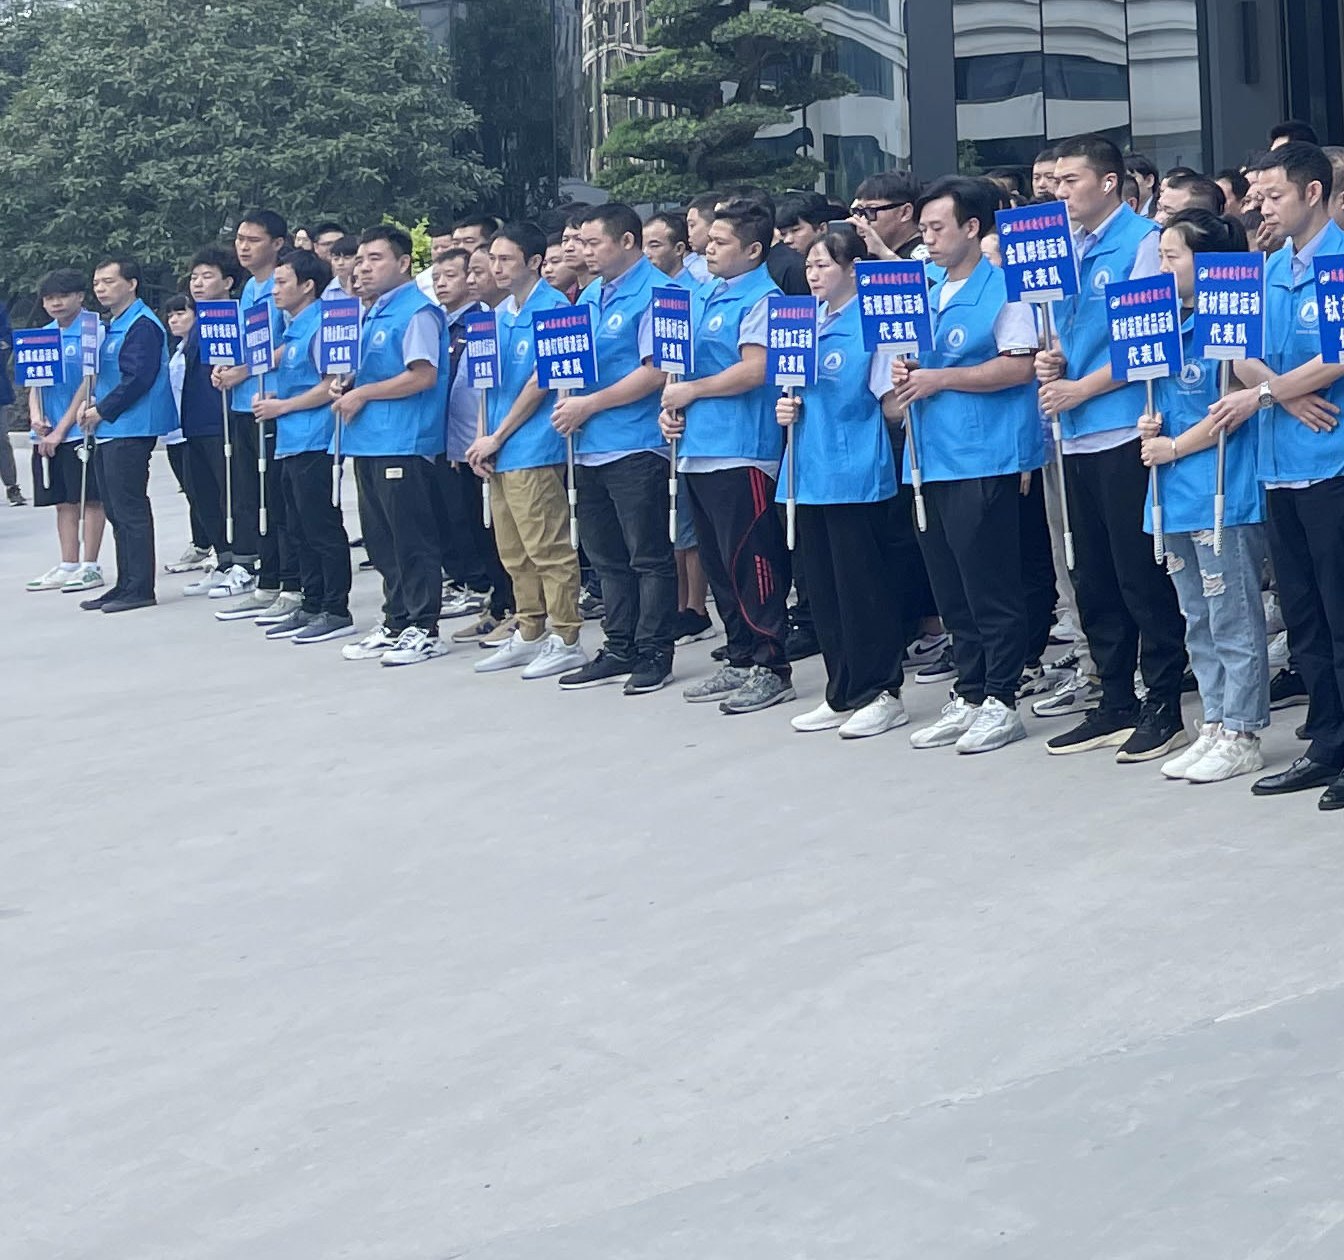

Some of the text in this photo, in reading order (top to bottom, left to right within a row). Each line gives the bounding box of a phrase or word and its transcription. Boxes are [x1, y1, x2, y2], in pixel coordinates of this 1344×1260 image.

[1022, 266, 1062, 289] 代表队
[879, 321, 917, 340] 代表队
[1210, 323, 1247, 344] 代表队
[662, 342, 684, 360] 代表队
[1128, 342, 1167, 366] 代表队
[551, 358, 583, 377] 代表队
[778, 355, 805, 373] 代表队
